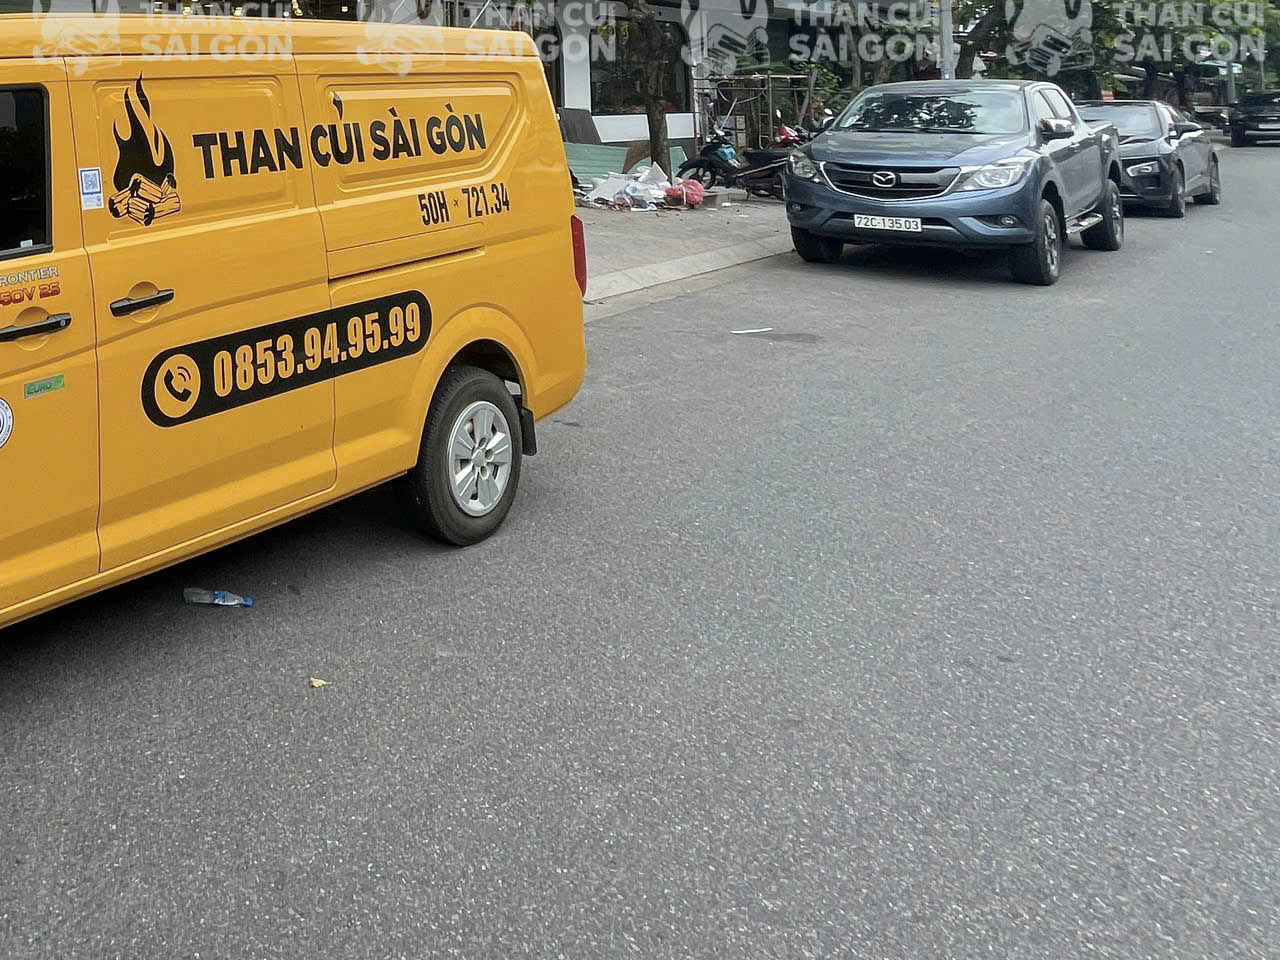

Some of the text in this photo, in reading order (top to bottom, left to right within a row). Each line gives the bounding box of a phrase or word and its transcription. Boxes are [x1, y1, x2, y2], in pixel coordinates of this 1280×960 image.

[192, 127, 304, 179] THAN
[370, 107, 421, 160] SÀI
[426, 103, 487, 155] GÒN
[417, 182, 510, 225] 50H 721.34
[212, 302, 421, 398] 0853.94.95.99
